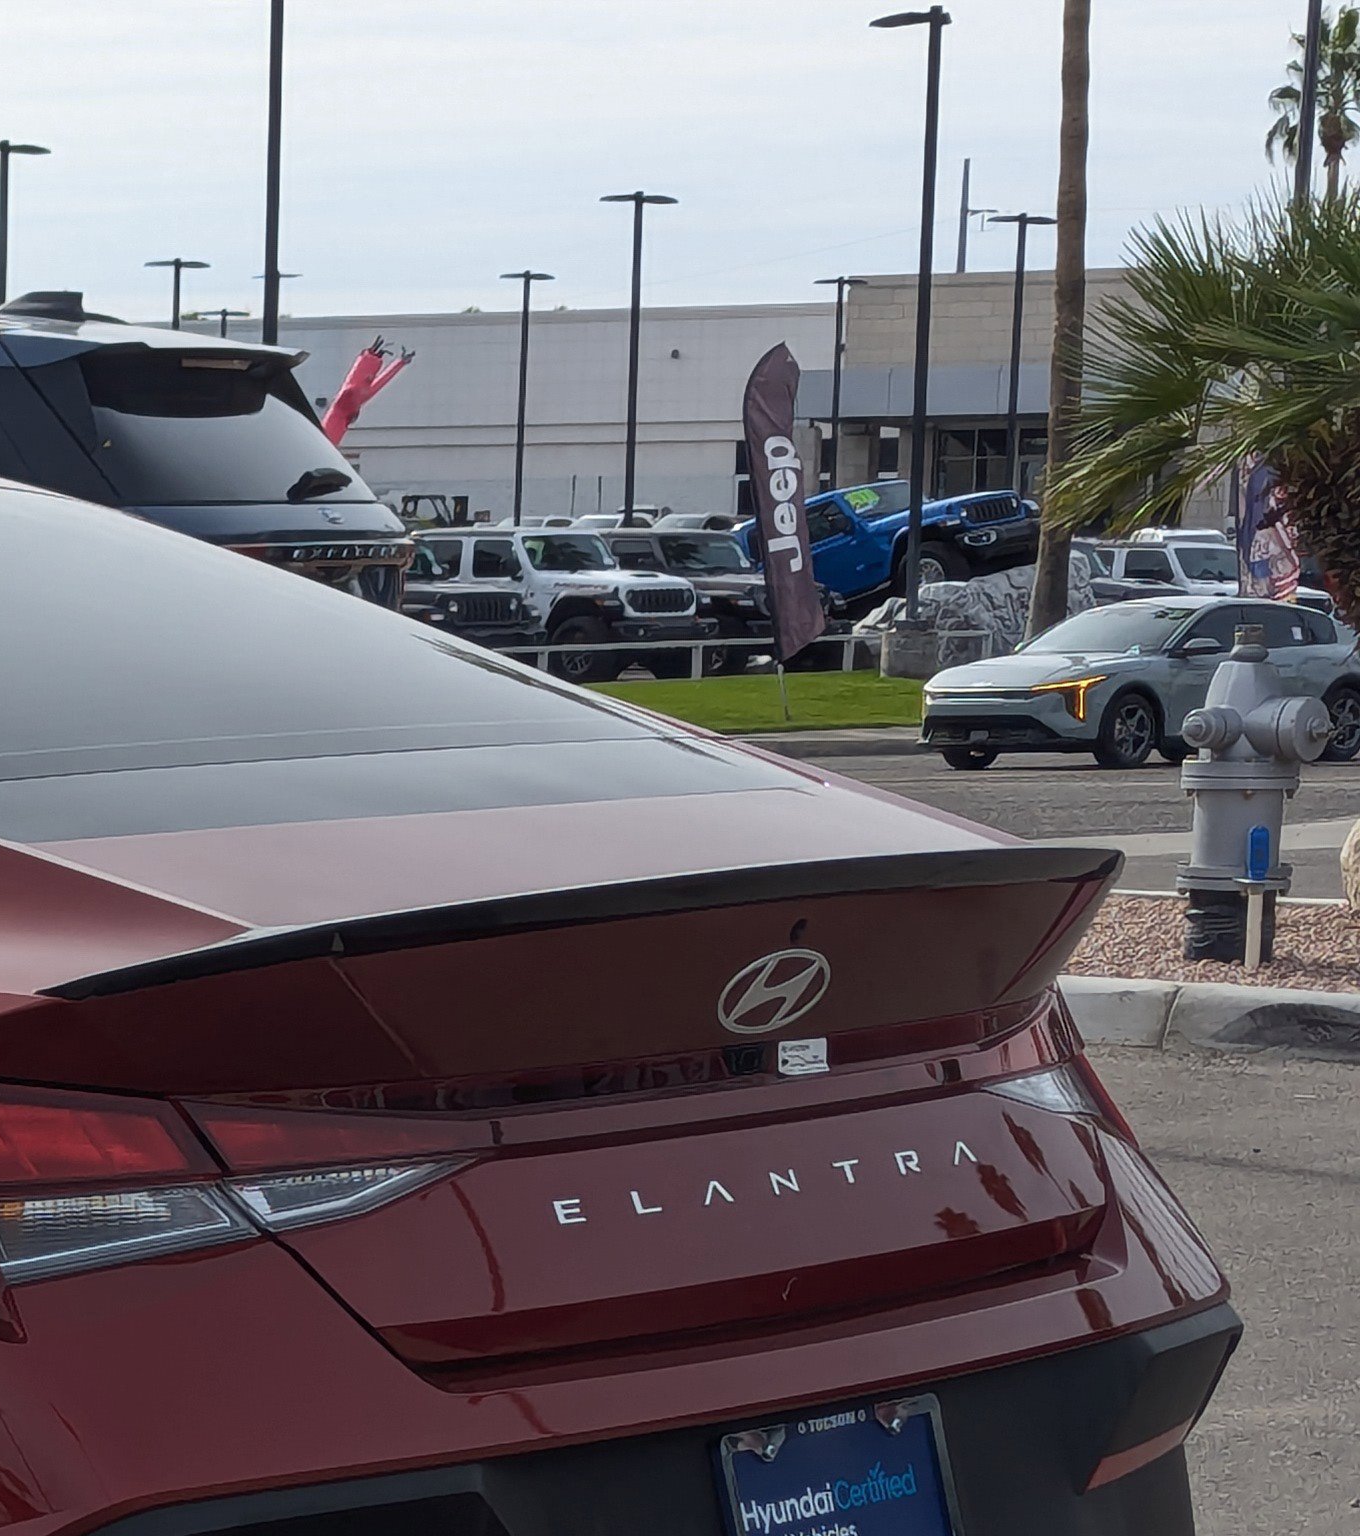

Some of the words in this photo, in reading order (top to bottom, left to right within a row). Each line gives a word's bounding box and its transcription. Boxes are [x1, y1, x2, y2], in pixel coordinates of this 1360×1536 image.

[764, 435, 803, 573] Jeep
[552, 1140, 978, 1225] ELANTRA
[739, 1482, 835, 1534] Hyundai
